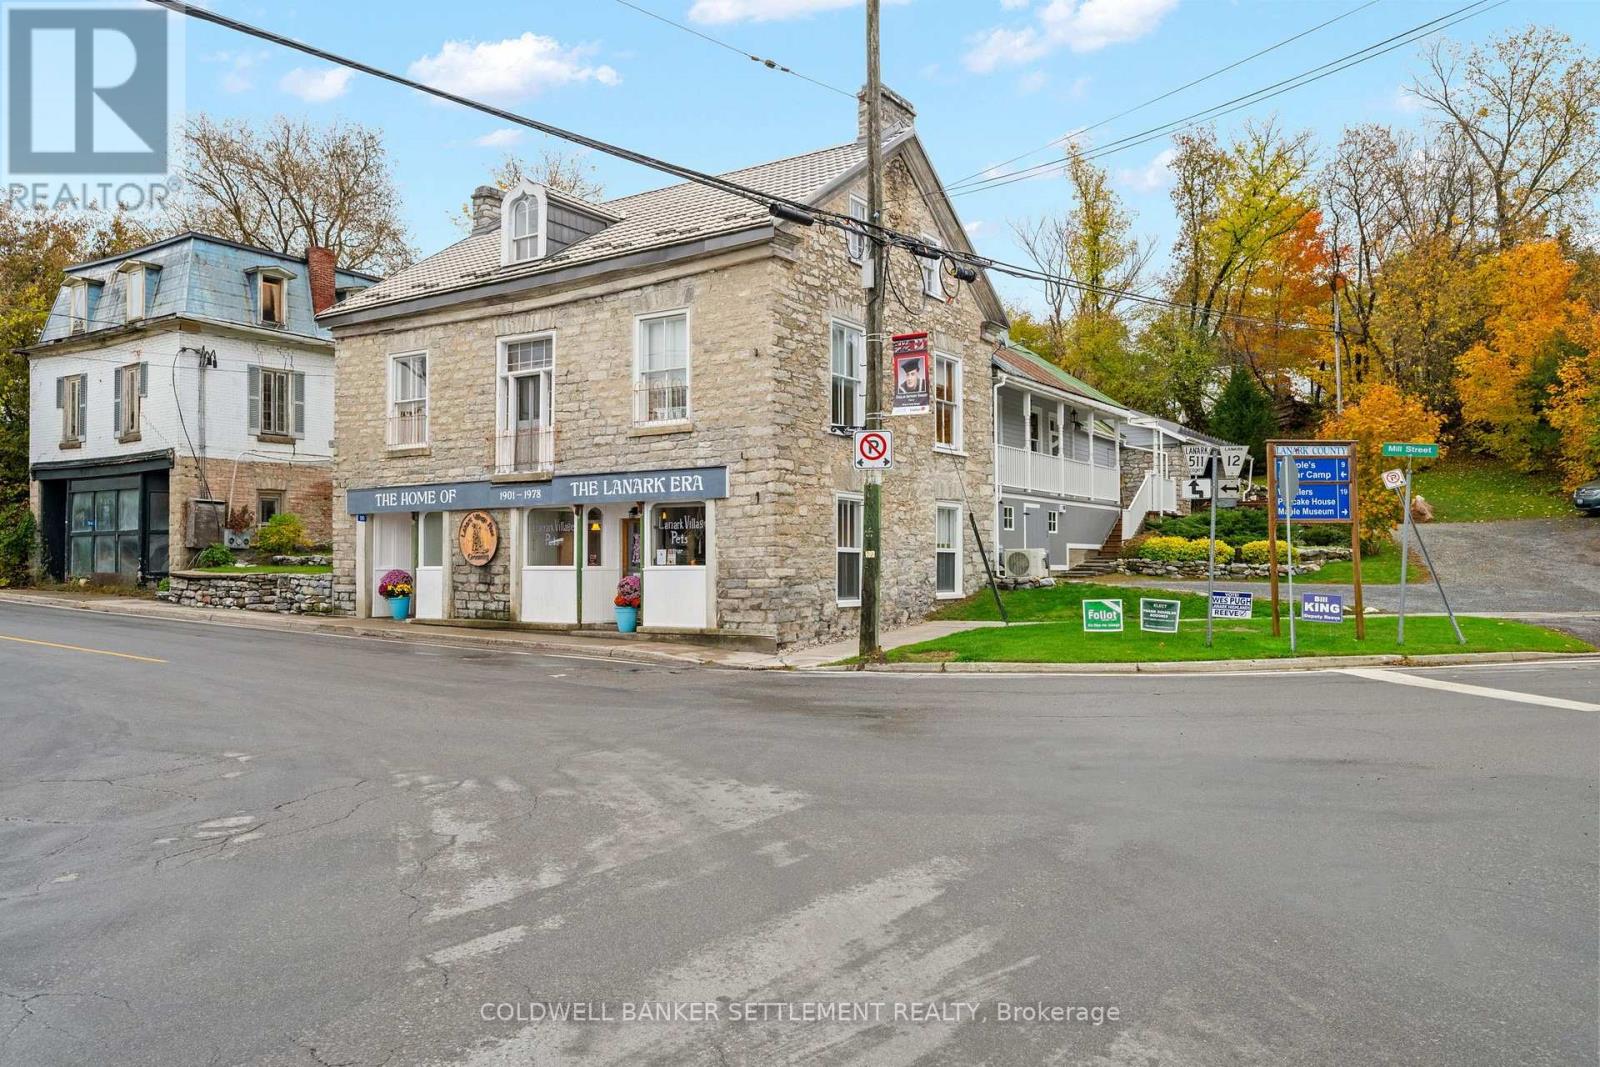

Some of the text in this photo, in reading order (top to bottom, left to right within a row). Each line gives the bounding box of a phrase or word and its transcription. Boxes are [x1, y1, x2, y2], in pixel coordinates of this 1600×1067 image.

[1312, 446, 1347, 455] COUNTY
[1388, 445, 1432, 454] Mill Street
[1189, 456, 1204, 467] 511
[1227, 455, 1241, 467] 12
[1306, 470, 1331, 480] Camp
[570, 475, 704, 497] THE LANARK ERA
[375, 489, 457, 507] THE HOME OF
[499, 491, 515, 500] 1901
[524, 489, 541, 499] 1978
[1311, 498, 1336, 506] House
[1302, 507, 1334, 515] Museum
[659, 516, 684, 530] Lanark
[671, 530, 688, 544] Pets
[1230, 597, 1251, 605] PUGH
[1214, 609, 1239, 617] REEVE
[1304, 602, 1340, 614] KING
